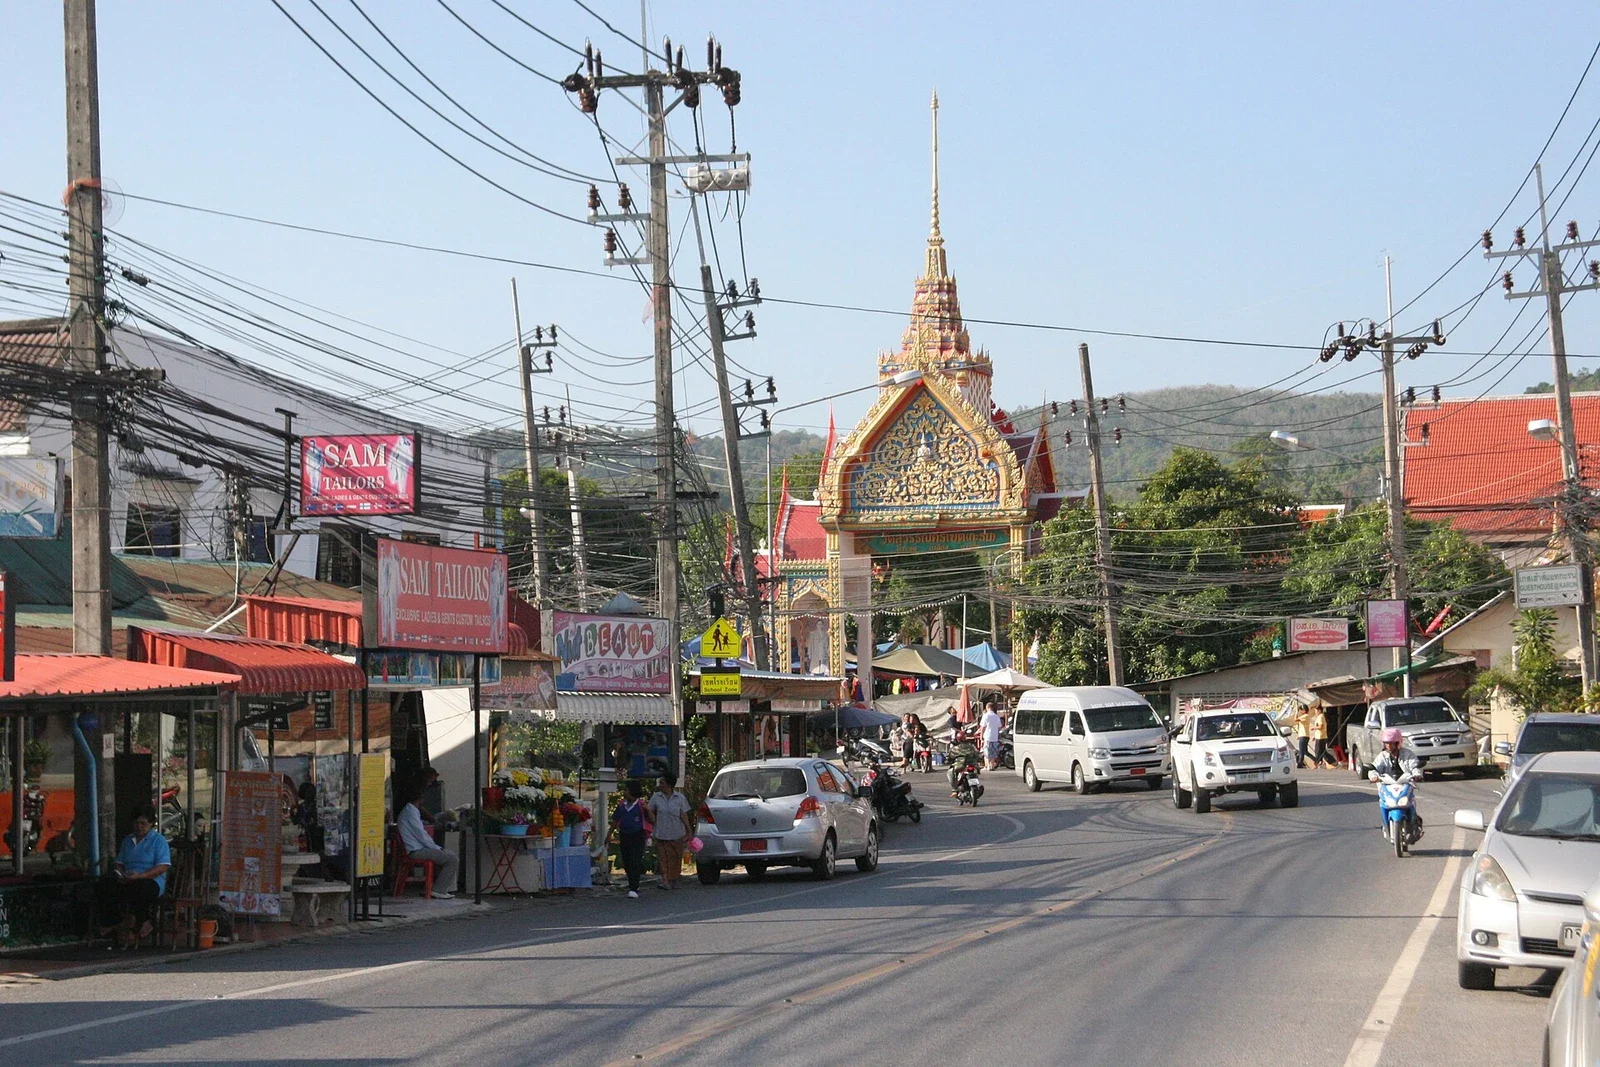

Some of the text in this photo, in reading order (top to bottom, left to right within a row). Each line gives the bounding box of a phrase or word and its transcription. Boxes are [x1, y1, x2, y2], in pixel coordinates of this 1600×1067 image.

[323, 442, 387, 469] SAM
[322, 475, 386, 490] TAILORS
[400, 556, 490, 602] SAM TAILORS
[702, 676, 738, 686] เขตโรงเรียน
